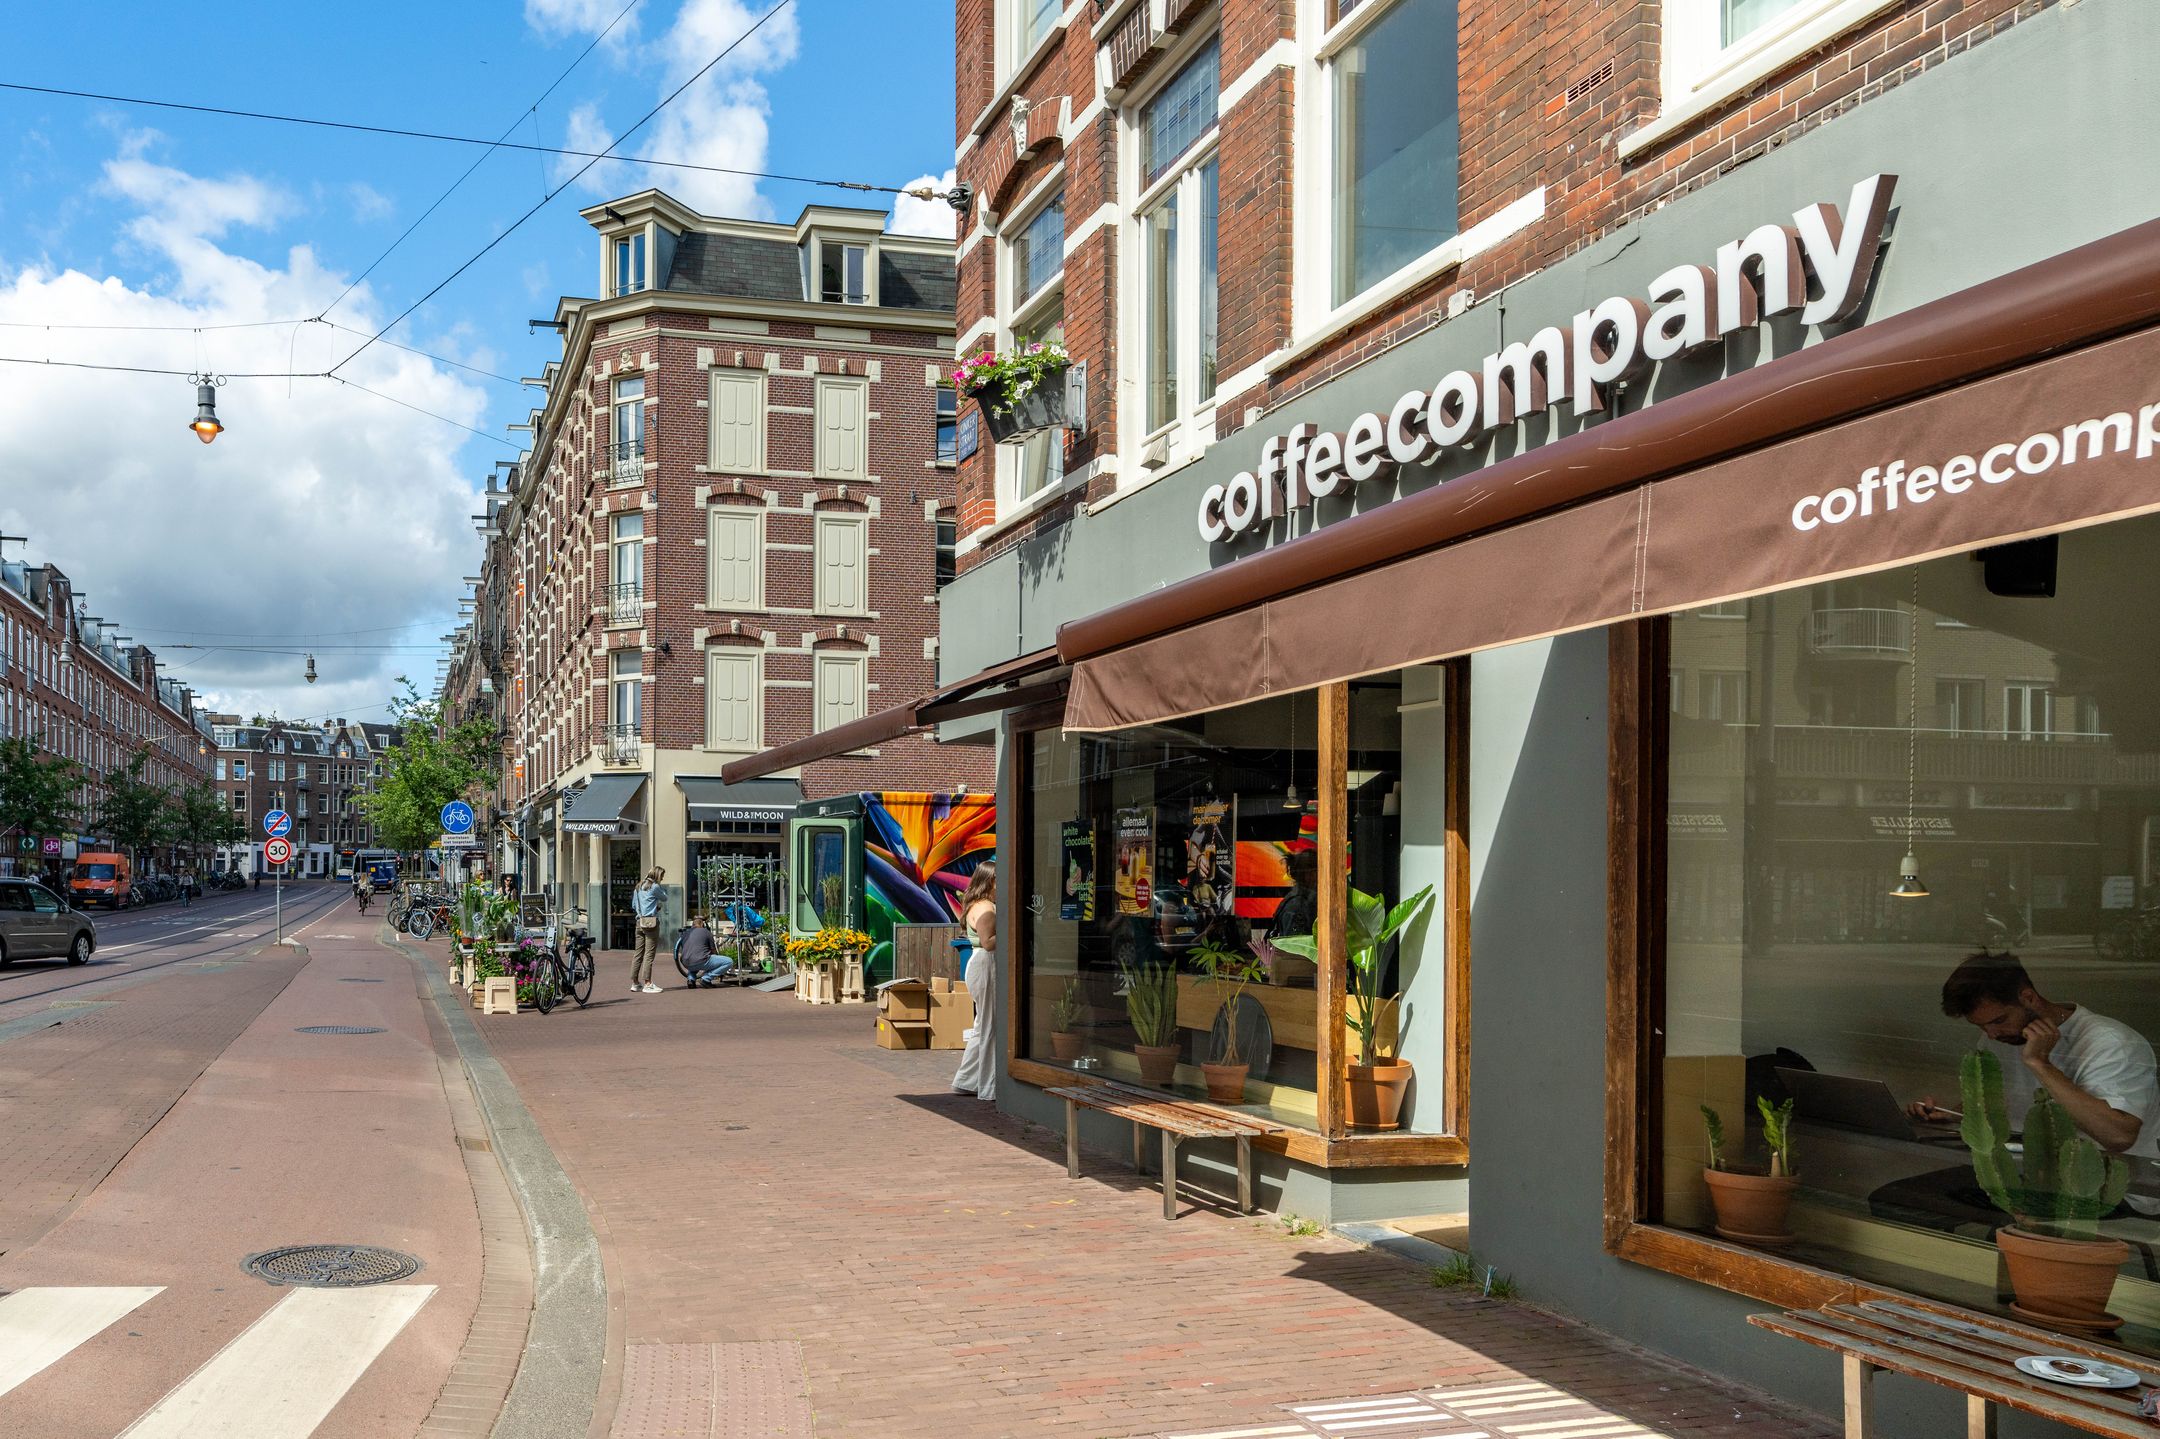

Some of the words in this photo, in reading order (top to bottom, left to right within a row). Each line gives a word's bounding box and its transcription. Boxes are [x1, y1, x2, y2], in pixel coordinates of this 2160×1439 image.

[1197, 174, 1898, 542] coffeecompany
[1122, 815, 1148, 827] allemaal
[1135, 826, 1149, 837] cool
[45, 841, 59, 851] da
[270, 846, 287, 855] 30
[1031, 894, 1044, 908] 330
